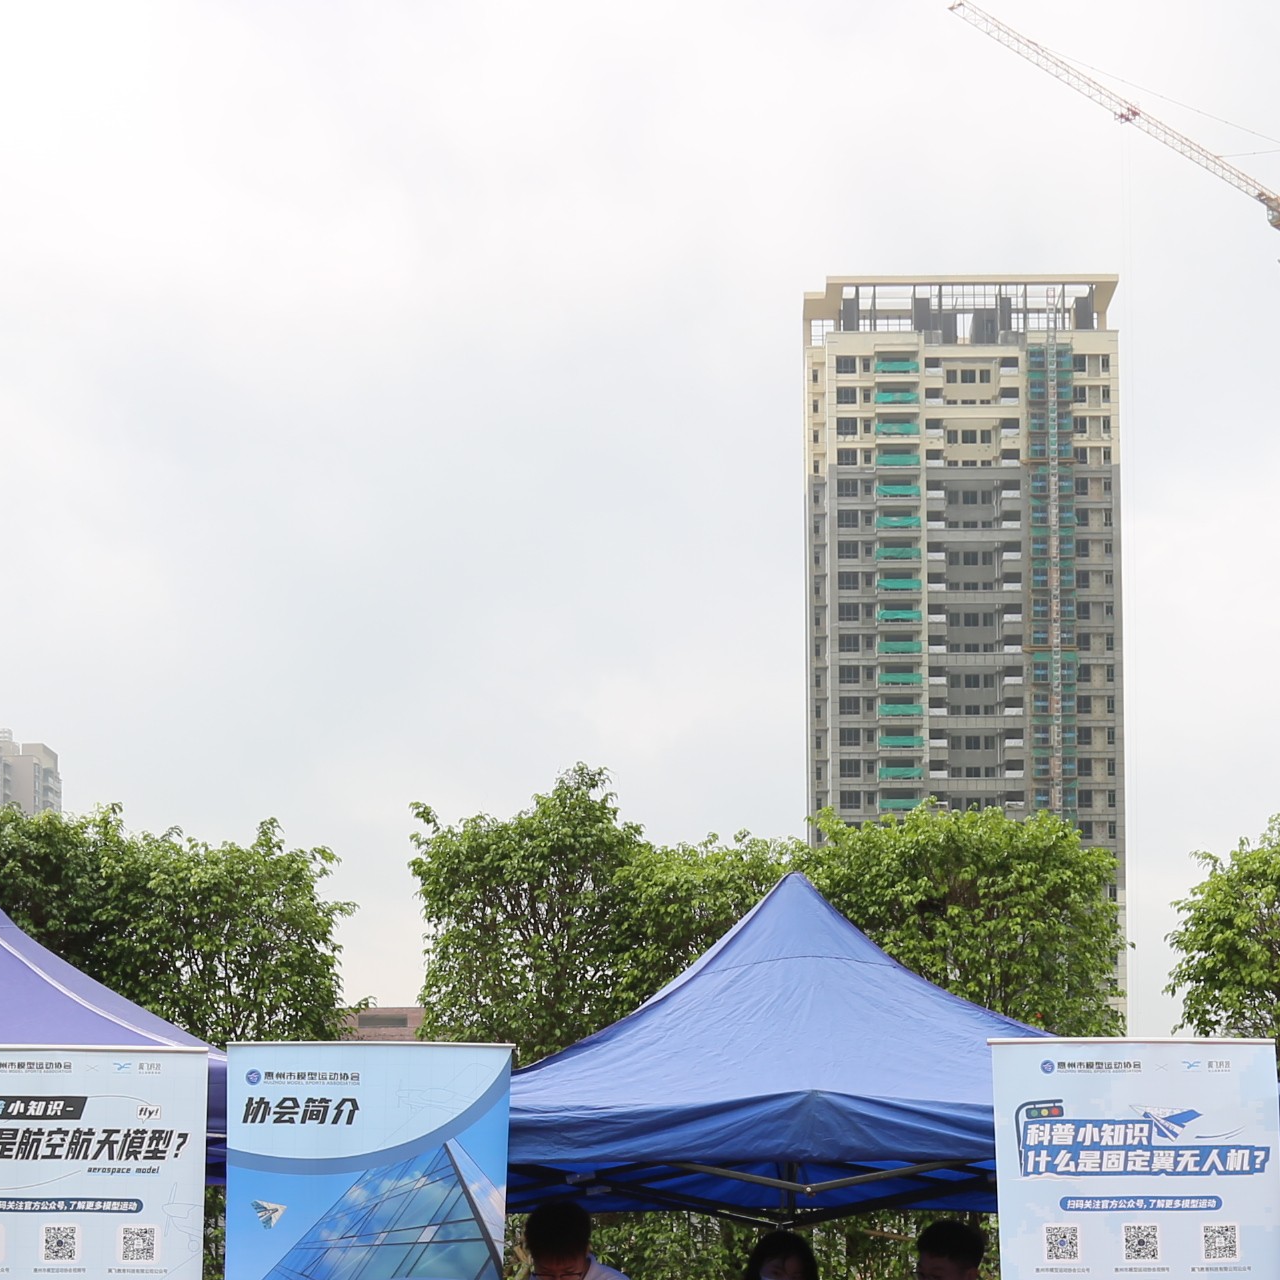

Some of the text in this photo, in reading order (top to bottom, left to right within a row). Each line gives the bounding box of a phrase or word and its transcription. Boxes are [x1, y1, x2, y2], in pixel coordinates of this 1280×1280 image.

[264, 1071, 360, 1081] 惠州市模型运动协会
[139, 1107, 159, 1118] fly!
[242, 1097, 360, 1125] 协会简介
[87, 1166, 160, 1175] aerospace model
